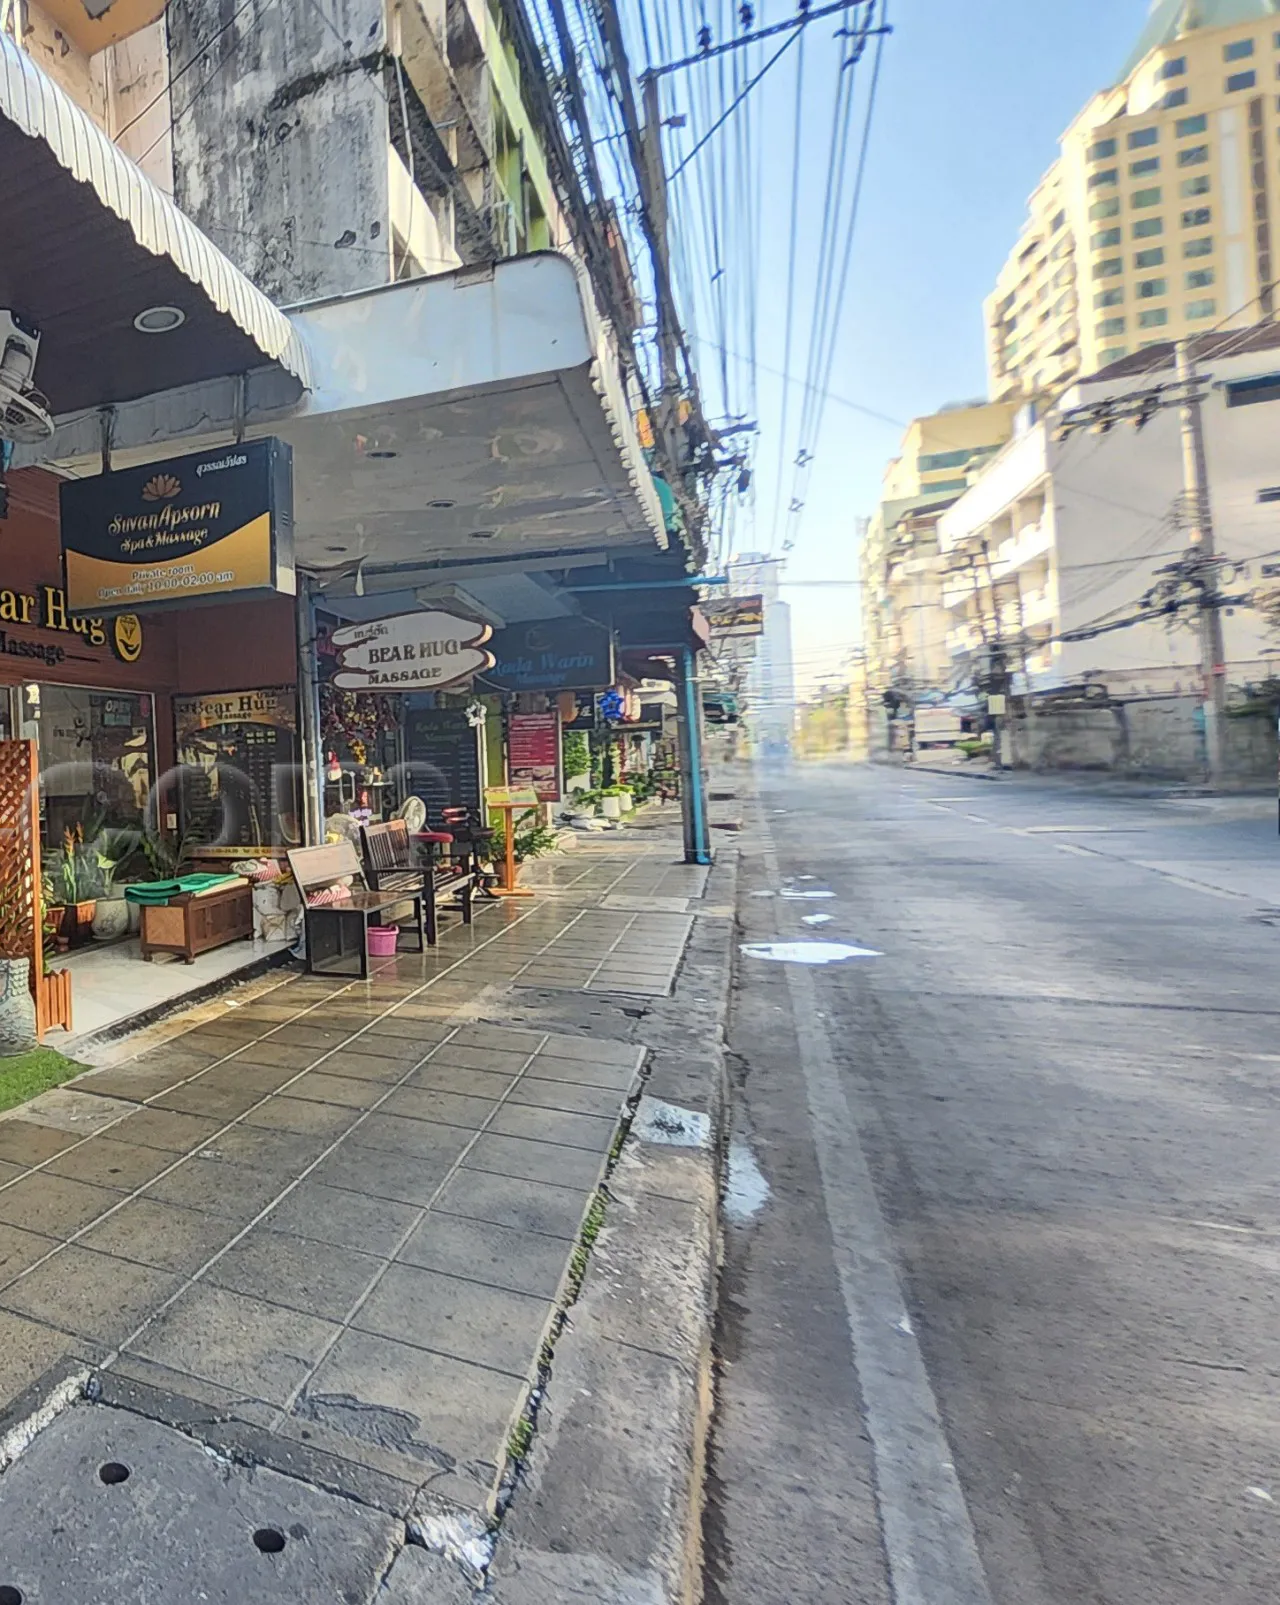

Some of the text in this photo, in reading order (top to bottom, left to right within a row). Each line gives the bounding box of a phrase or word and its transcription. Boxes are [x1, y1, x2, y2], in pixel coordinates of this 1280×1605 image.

[108, 501, 221, 535] SuvanApsorn
[168, 563, 195, 576] room
[368, 639, 460, 665] BEAR HUG
[367, 667, 442, 685] MASSAGE
